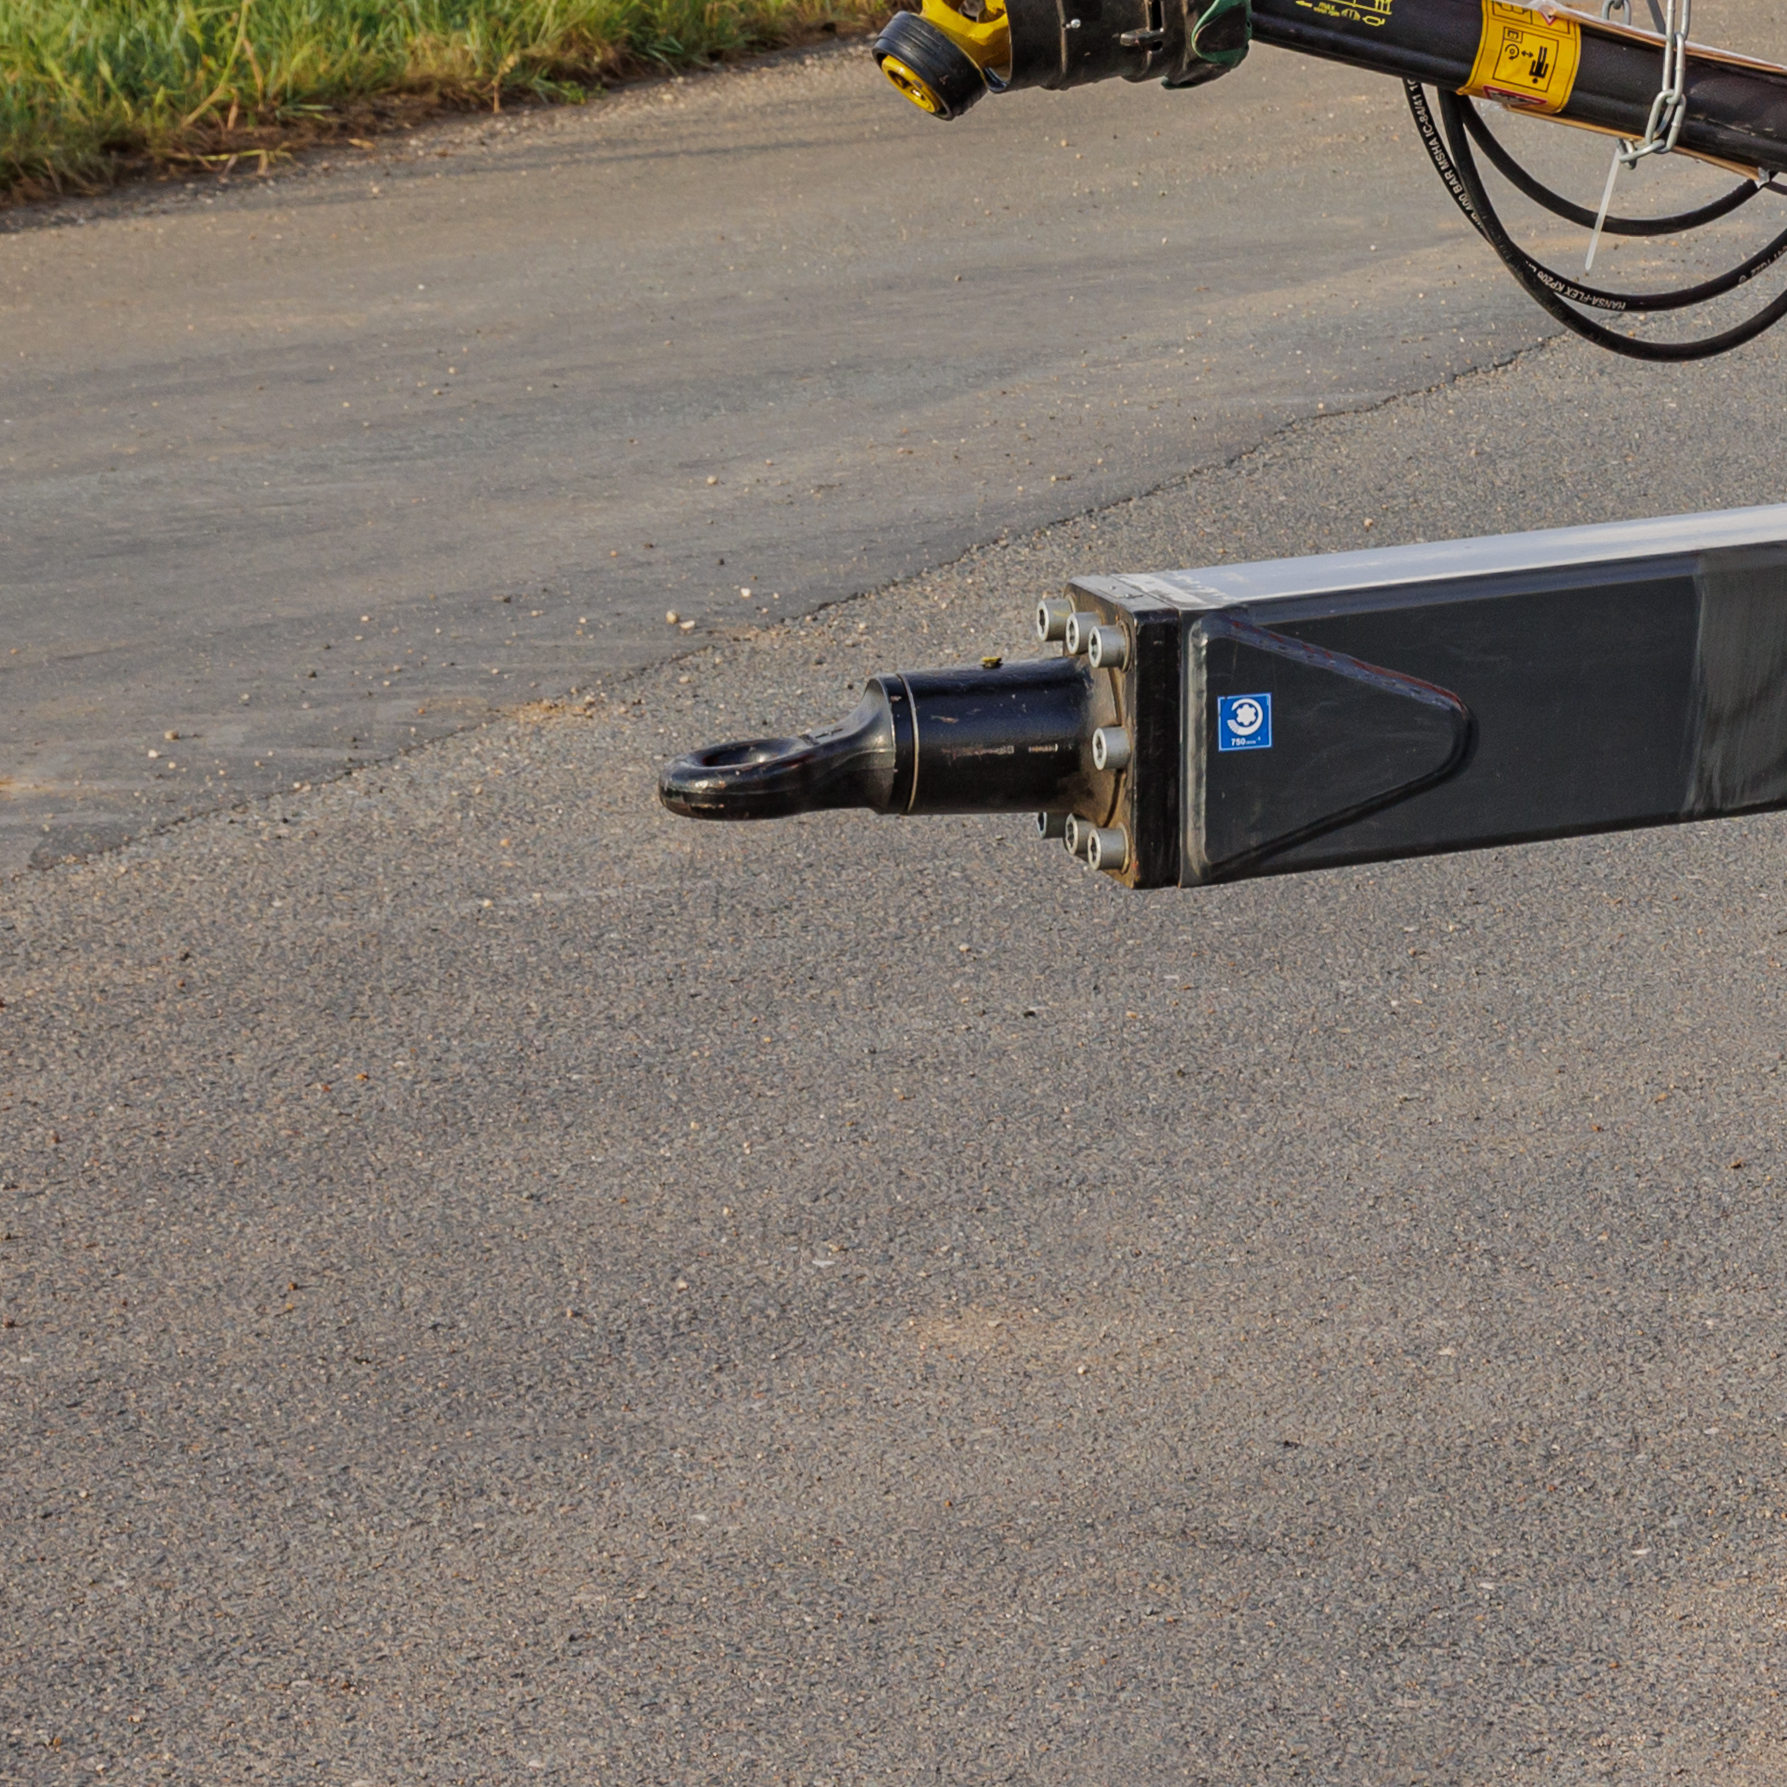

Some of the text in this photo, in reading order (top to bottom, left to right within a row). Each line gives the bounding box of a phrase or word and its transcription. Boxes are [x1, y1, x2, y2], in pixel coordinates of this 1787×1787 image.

[1412, 95, 1435, 137] IC-84/41
[1429, 139, 1450, 169] MSHA
[1444, 170, 1462, 194] BAR
[1564, 285, 1627, 311] HANSA-FLEX
